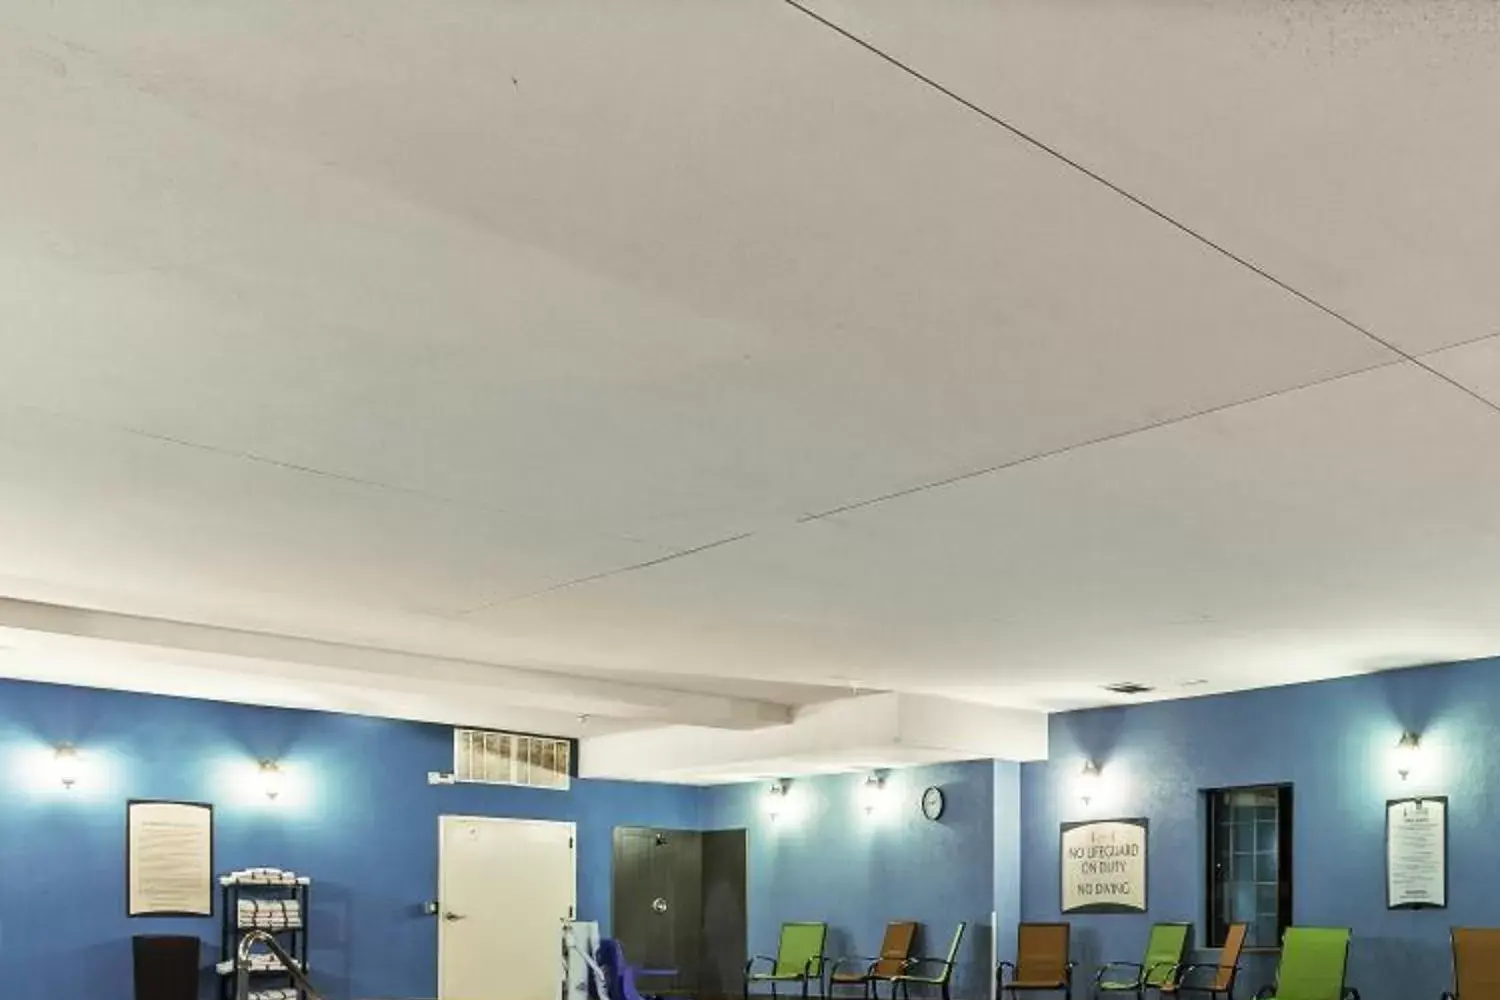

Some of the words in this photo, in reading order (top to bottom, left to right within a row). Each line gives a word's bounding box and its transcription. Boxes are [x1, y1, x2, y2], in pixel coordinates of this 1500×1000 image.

[1069, 846, 1085, 860] NO
[1087, 843, 1139, 859] LIFEGUARD
[1081, 860, 1097, 874] ON
[1099, 859, 1127, 874] DUTY
[1077, 883, 1093, 897] NO
[1095, 881, 1130, 896] DIVING
